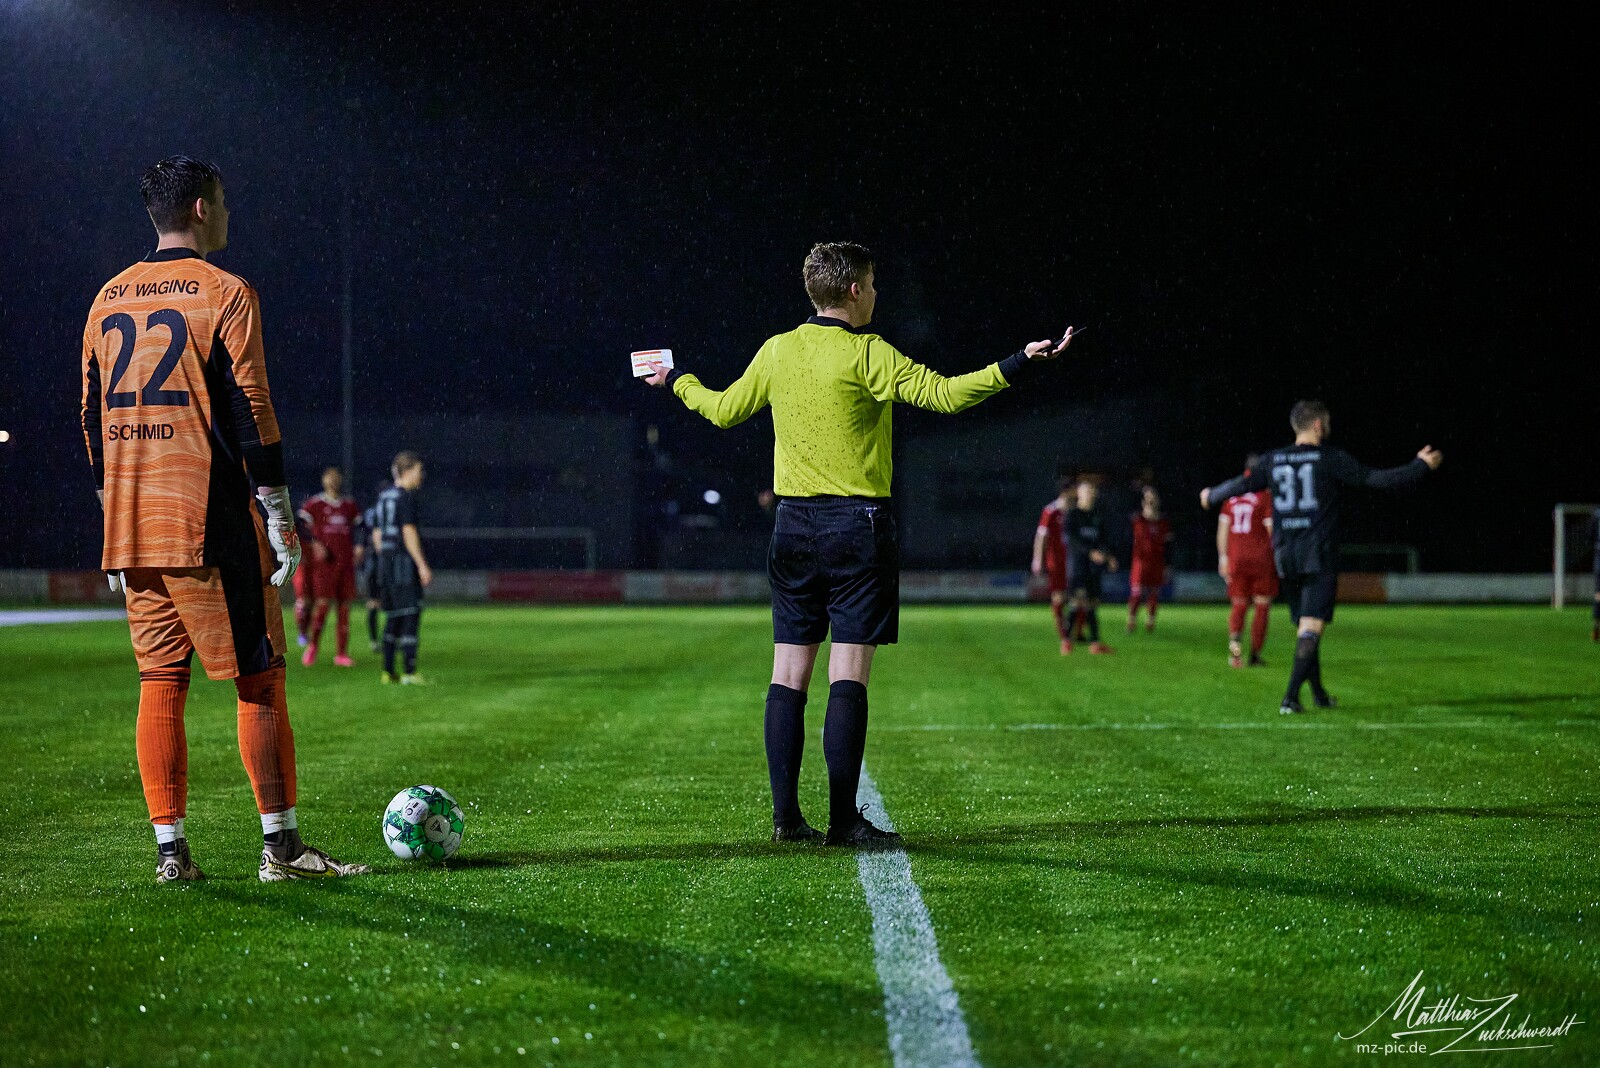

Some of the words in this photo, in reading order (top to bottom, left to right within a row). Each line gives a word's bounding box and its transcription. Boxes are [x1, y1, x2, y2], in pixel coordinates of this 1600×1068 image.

[103, 284, 129, 302] TSV
[135, 279, 200, 297] WAGING
[101, 308, 190, 412] 22
[108, 423, 175, 441] SCHMID
[1272, 463, 1319, 512] 31
